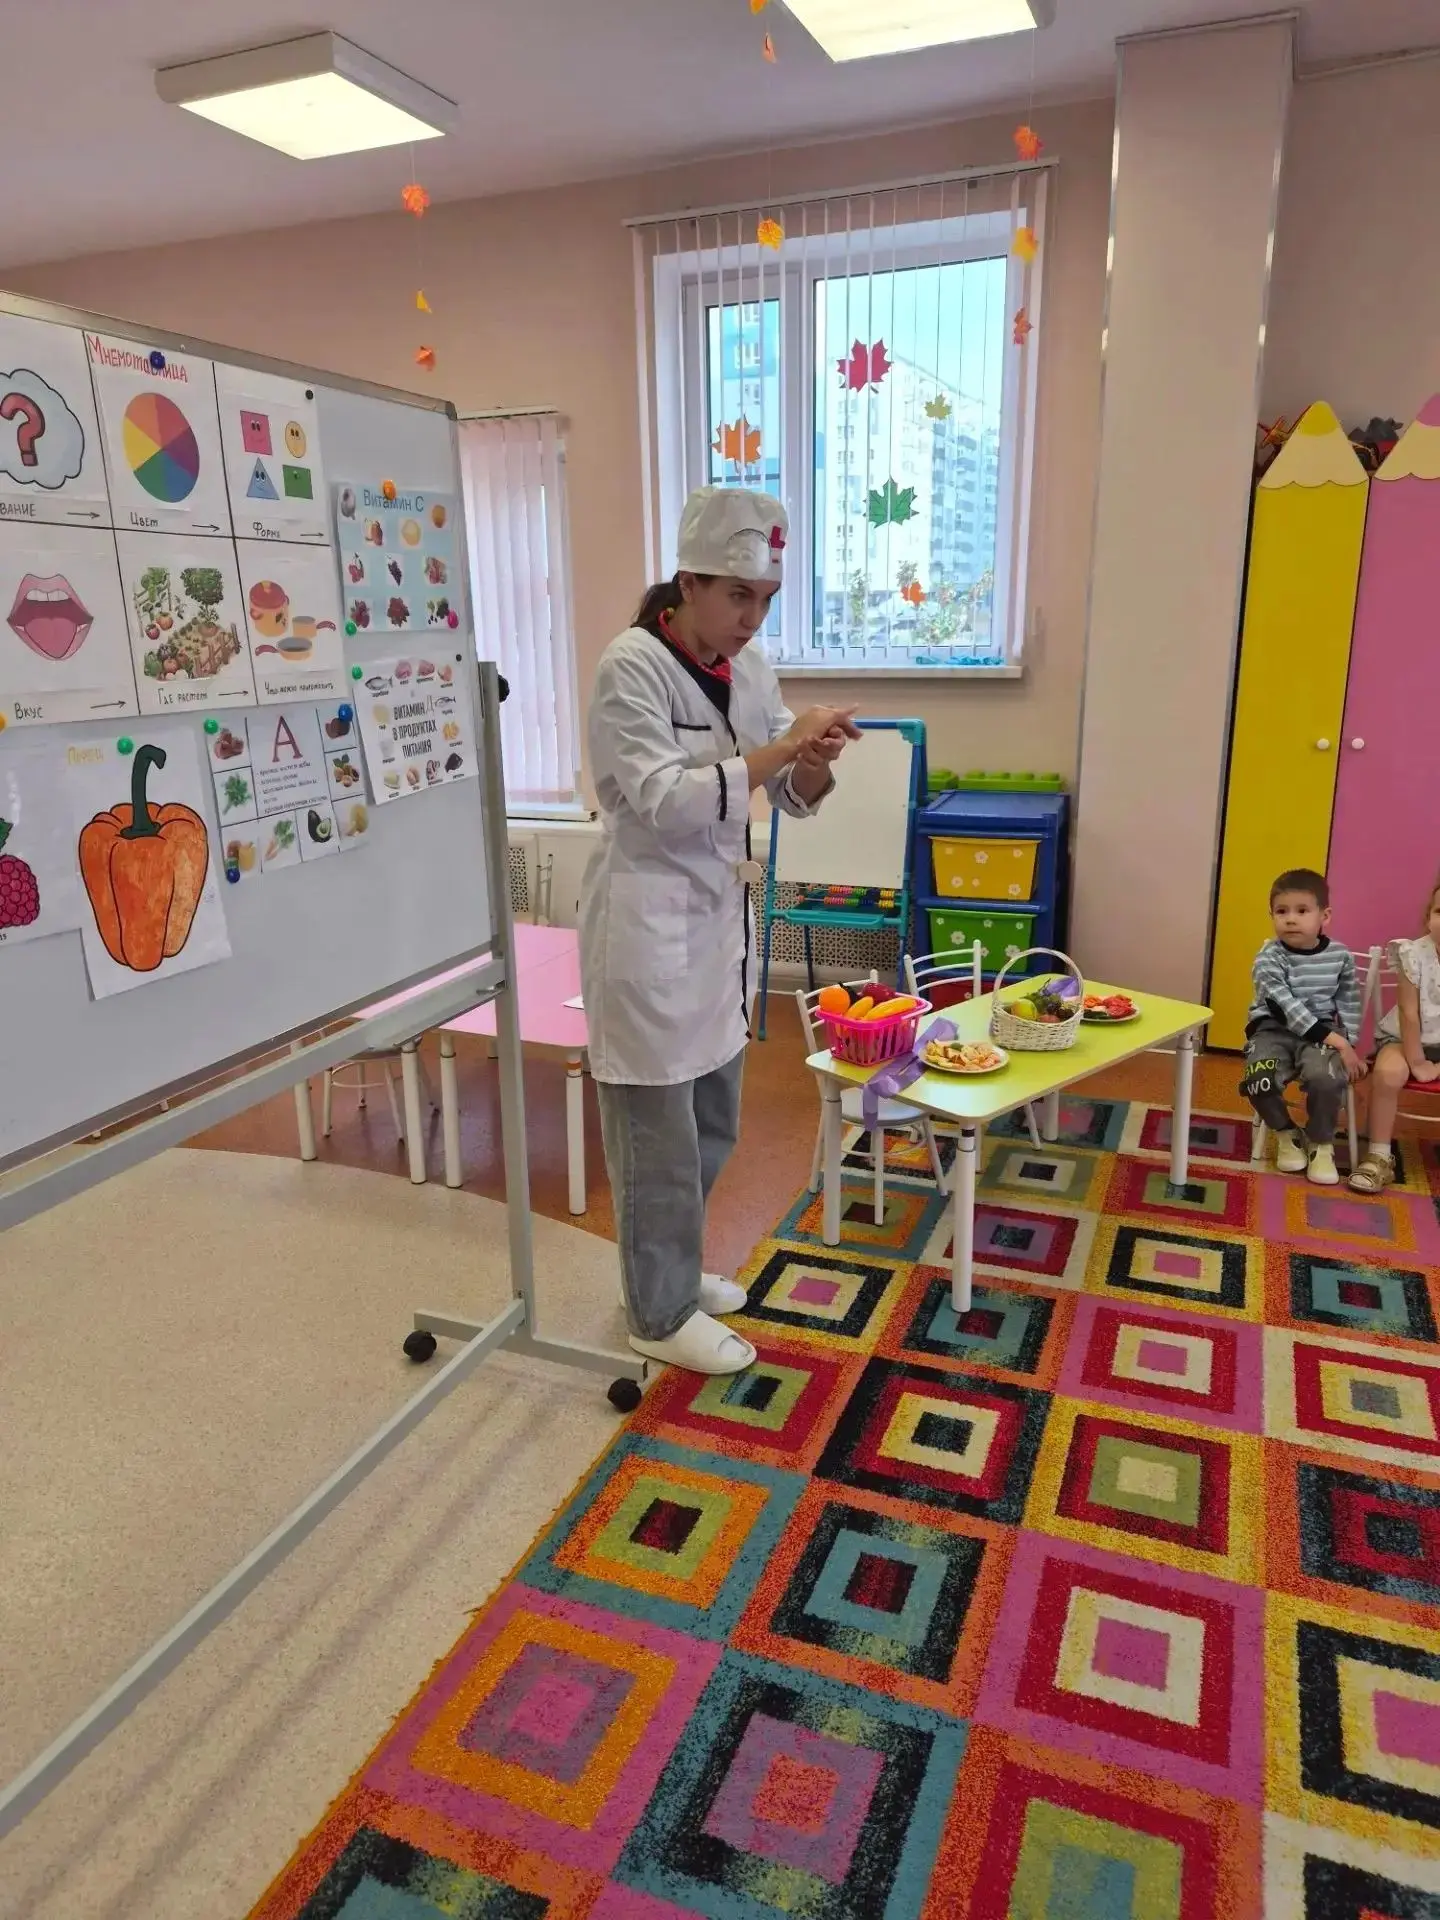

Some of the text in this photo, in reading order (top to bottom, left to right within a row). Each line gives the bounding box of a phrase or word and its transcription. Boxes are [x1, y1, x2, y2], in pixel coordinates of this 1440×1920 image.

[364, 489, 412, 511] Витамин
[393, 702, 425, 720] ВИТАМИН
[392, 719, 438, 741] В ПРОДУКТАХ
[402, 739, 433, 759] ПИТАНИЯ
